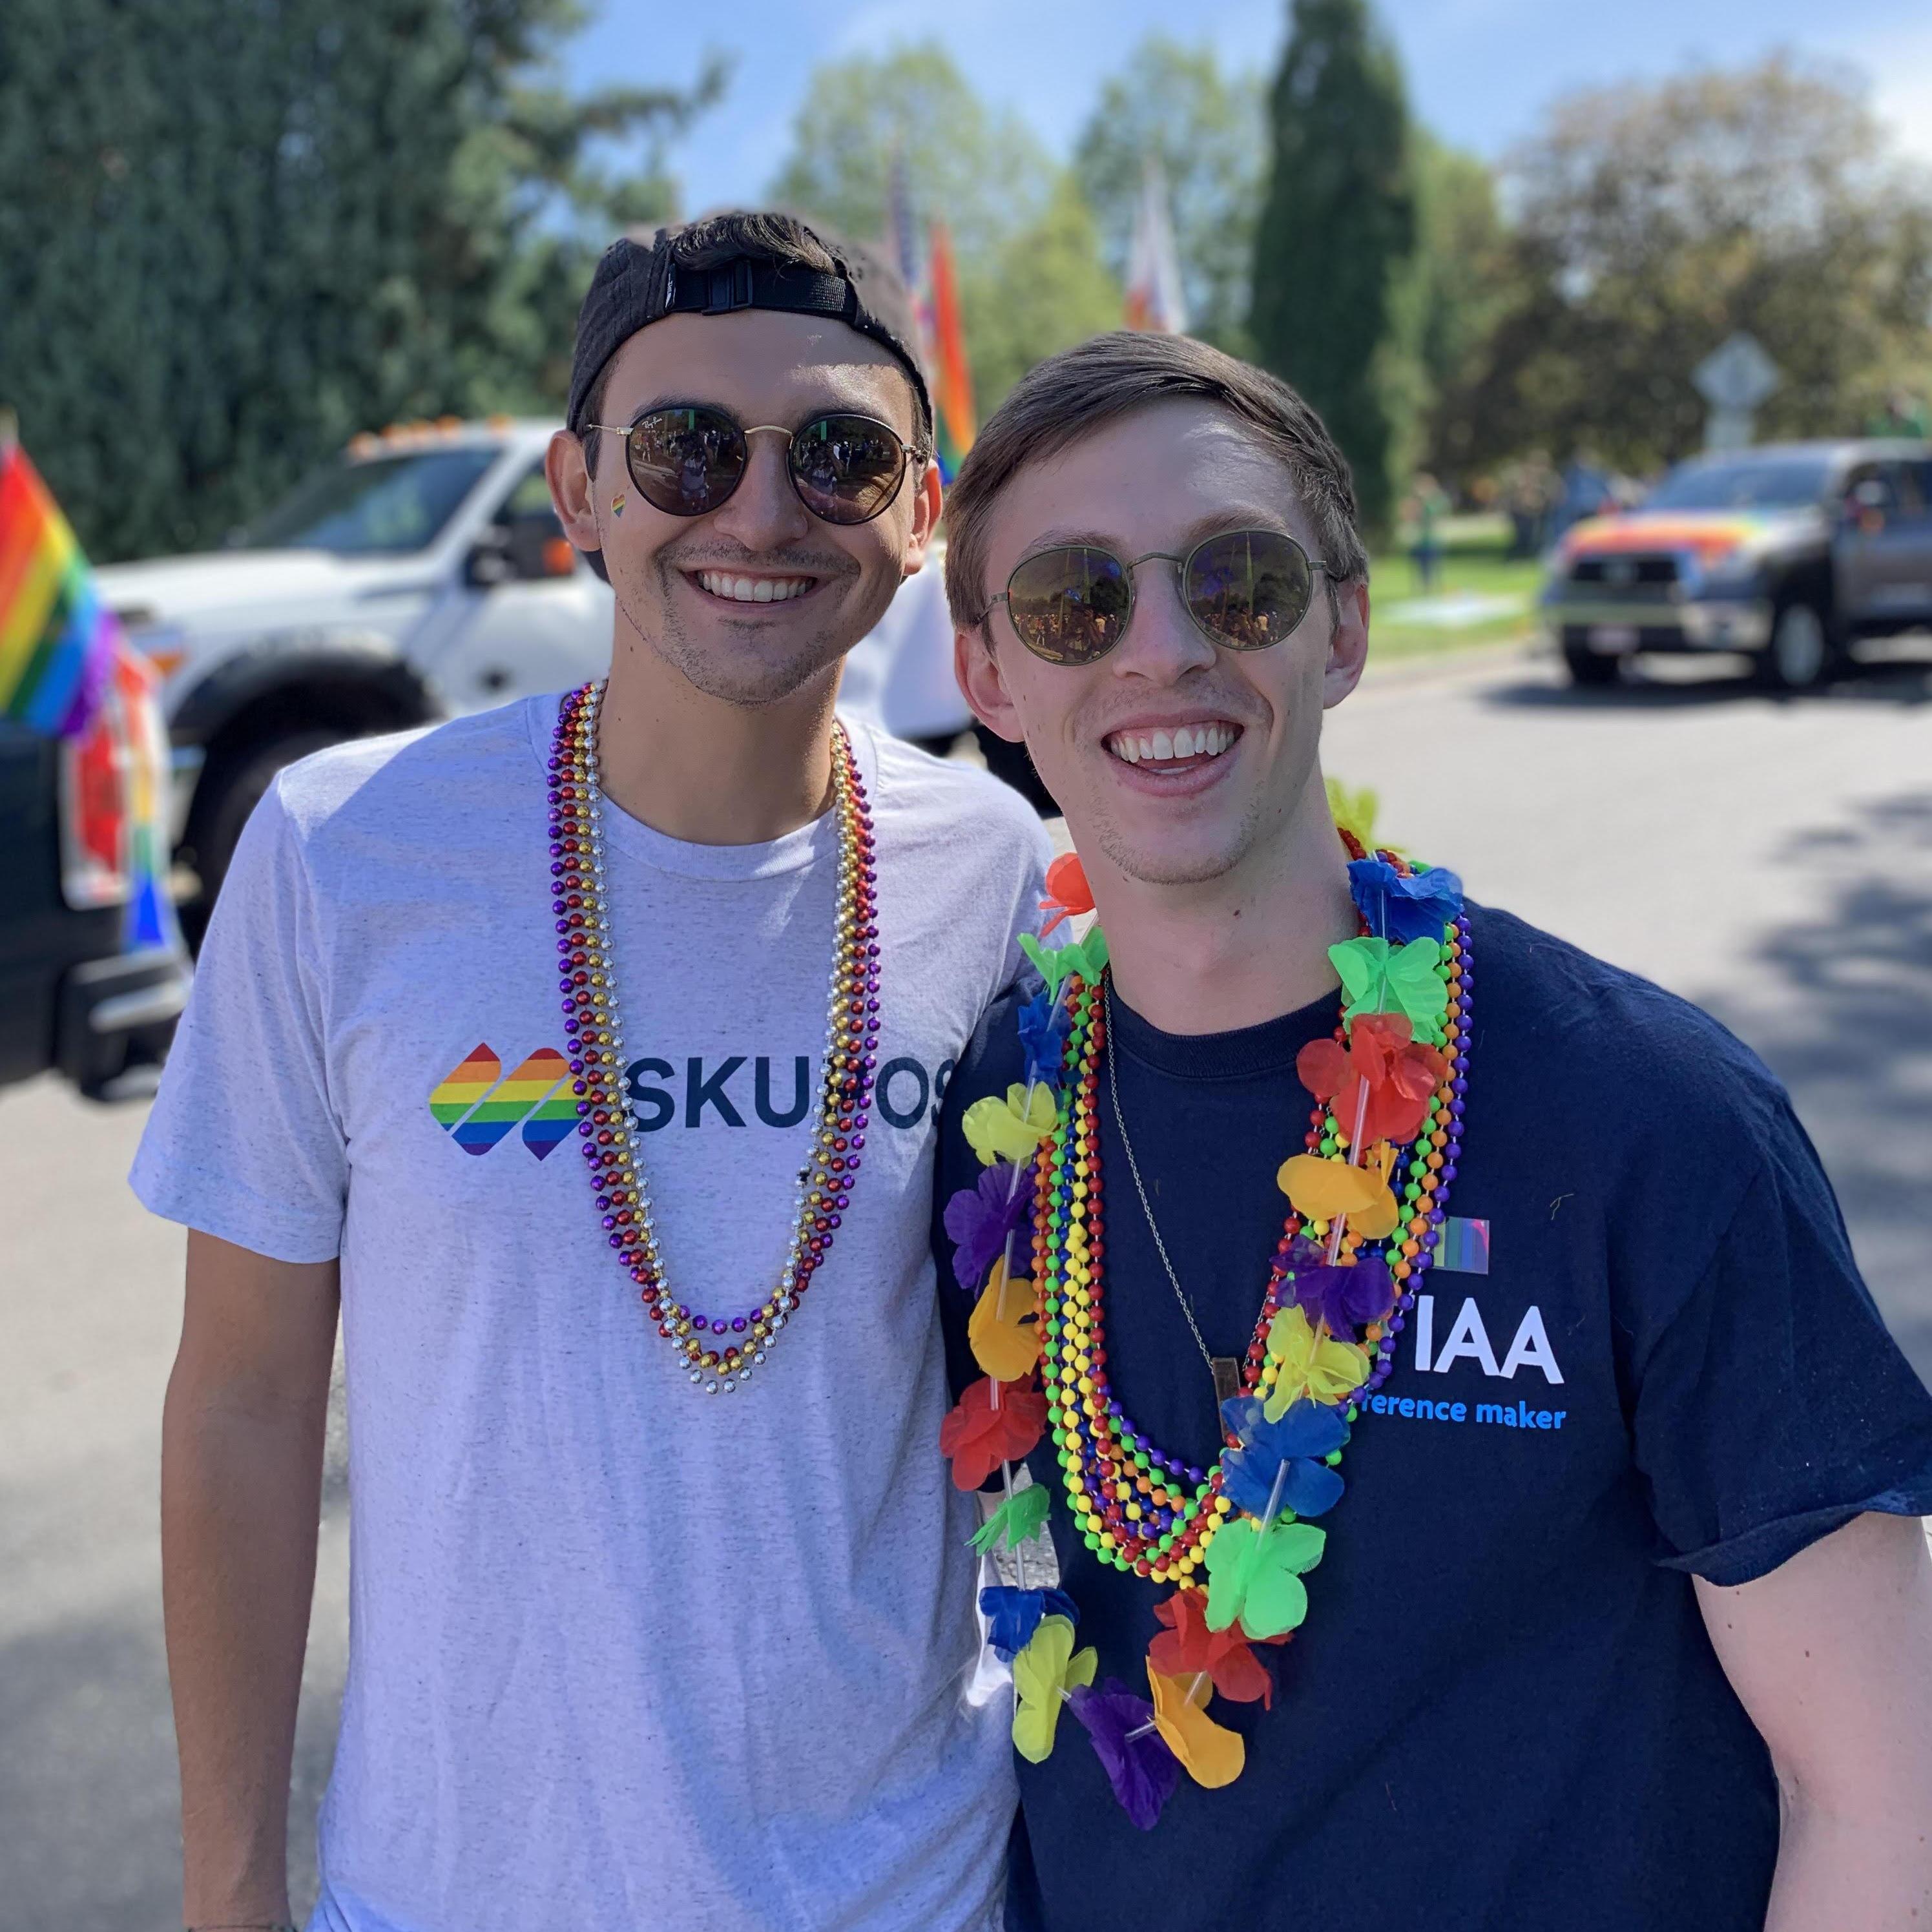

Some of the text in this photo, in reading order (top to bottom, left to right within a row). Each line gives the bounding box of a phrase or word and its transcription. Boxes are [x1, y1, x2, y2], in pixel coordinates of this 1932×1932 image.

[1376, 1294, 1565, 1384] IAA
[1361, 1385, 1567, 1429] ference maker
